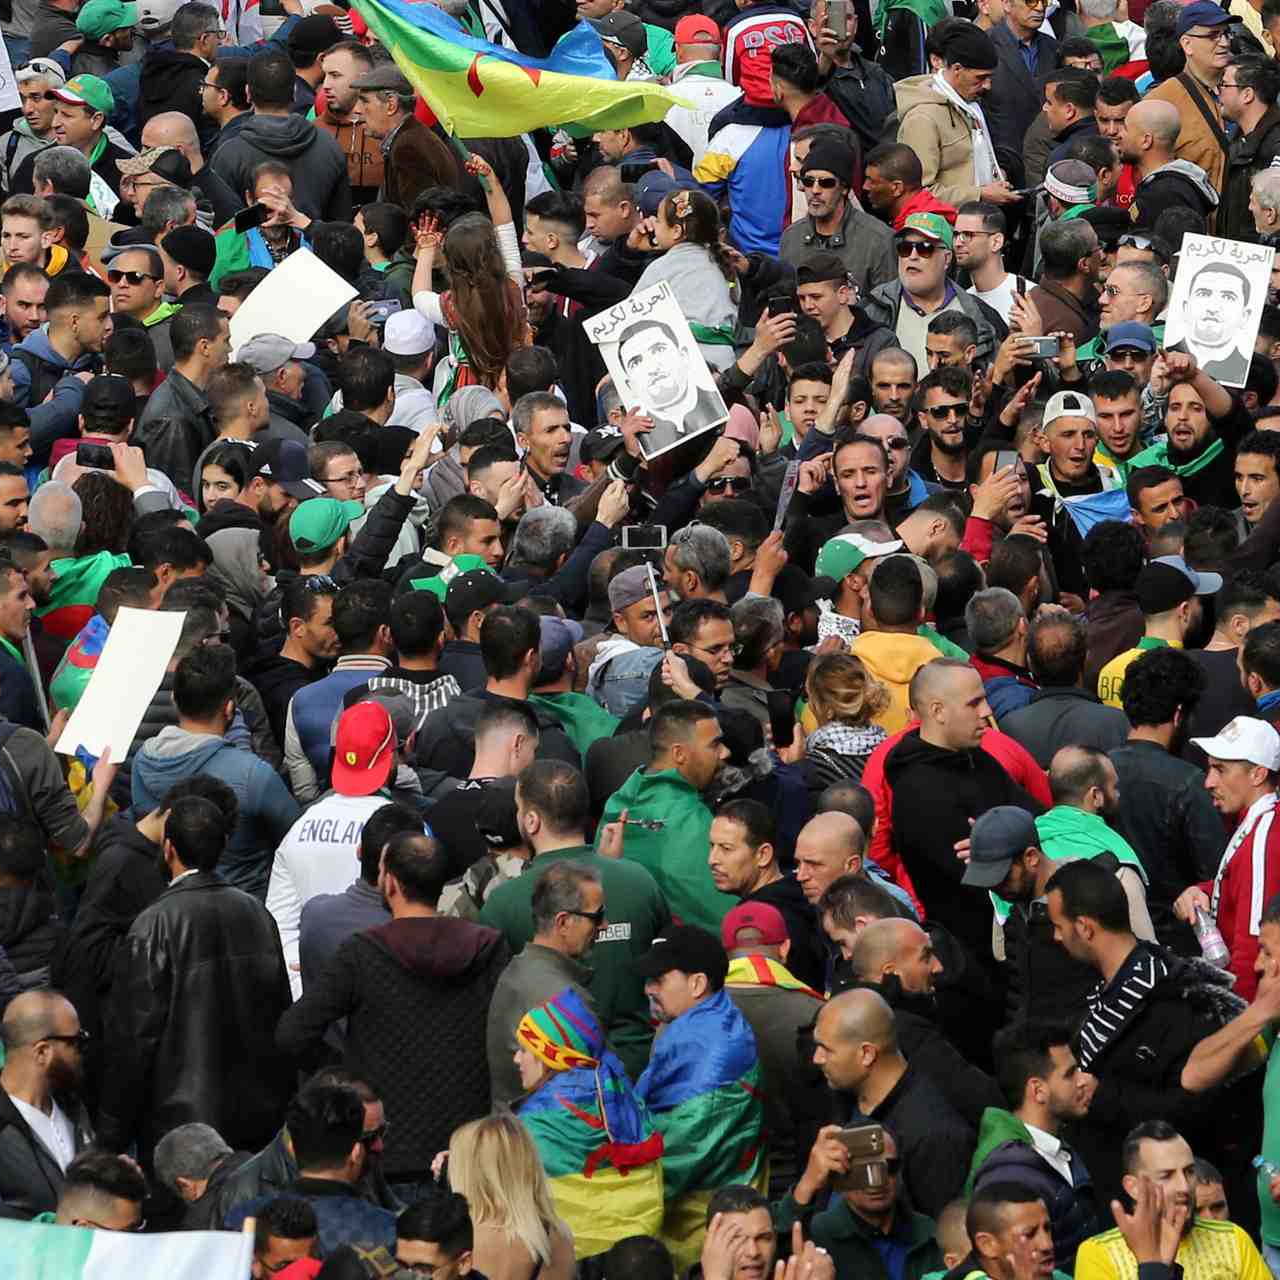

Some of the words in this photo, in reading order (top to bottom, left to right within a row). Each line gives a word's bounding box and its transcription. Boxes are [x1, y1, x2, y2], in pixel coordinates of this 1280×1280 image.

[1186, 239, 1226, 257] لكريم
[1230, 243, 1271, 264] الحرية
[631, 283, 670, 315] الحرية
[592, 306, 626, 340] لكريم
